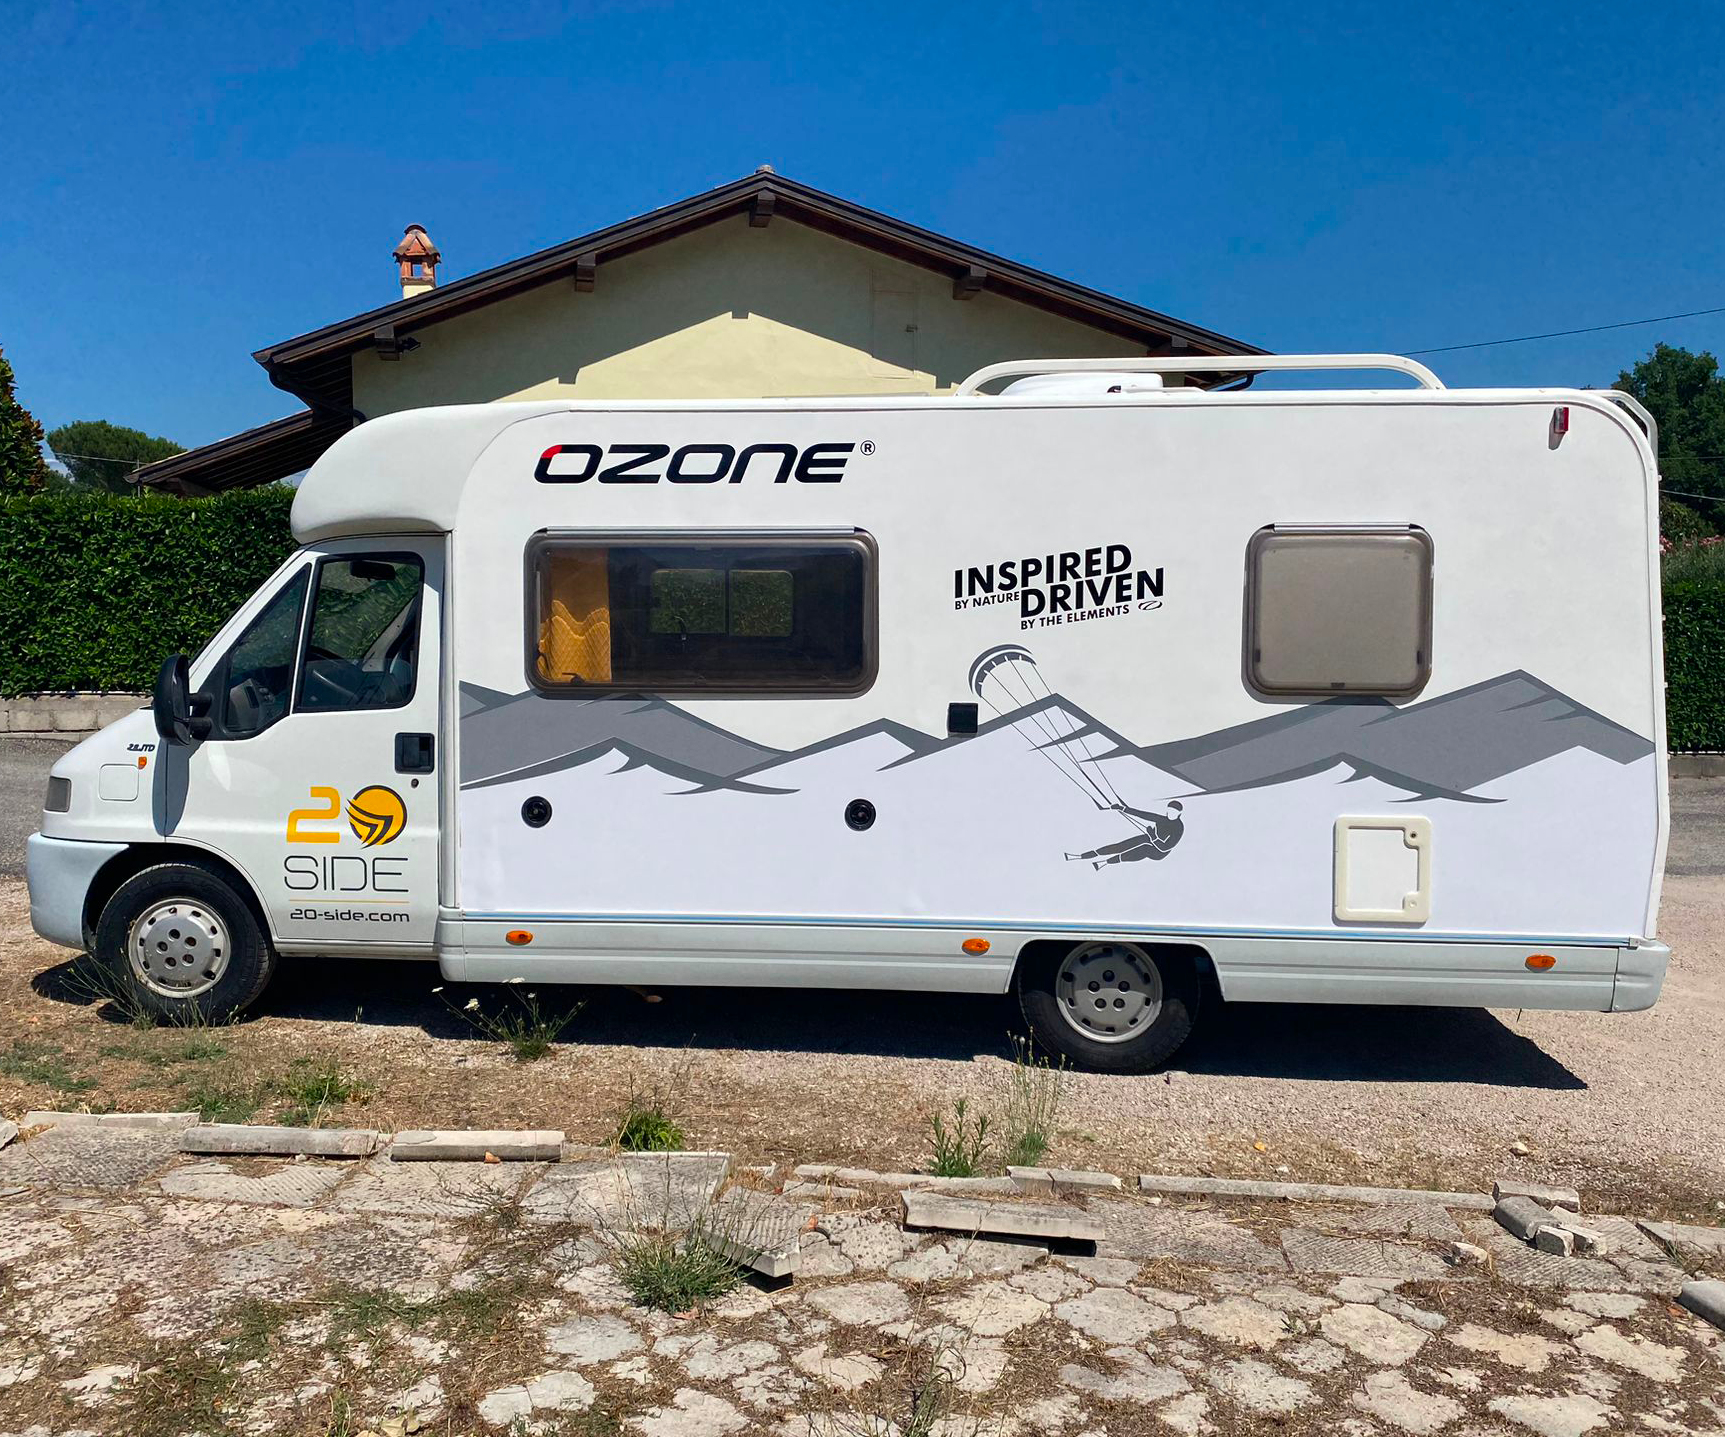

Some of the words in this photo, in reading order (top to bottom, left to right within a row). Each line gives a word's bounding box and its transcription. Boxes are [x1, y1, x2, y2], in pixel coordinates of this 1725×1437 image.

[954, 544, 1132, 598] INSPIRED
[954, 599, 969, 610] BY
[972, 591, 1020, 607] NATURE
[1020, 567, 1164, 618] DRIVEN
[1020, 619, 1036, 630] BY
[1039, 613, 1063, 627] THE
[1066, 604, 1130, 623] ELEMENTS
[284, 855, 409, 892] SIDE
[290, 908, 410, 922] 20-side.com
